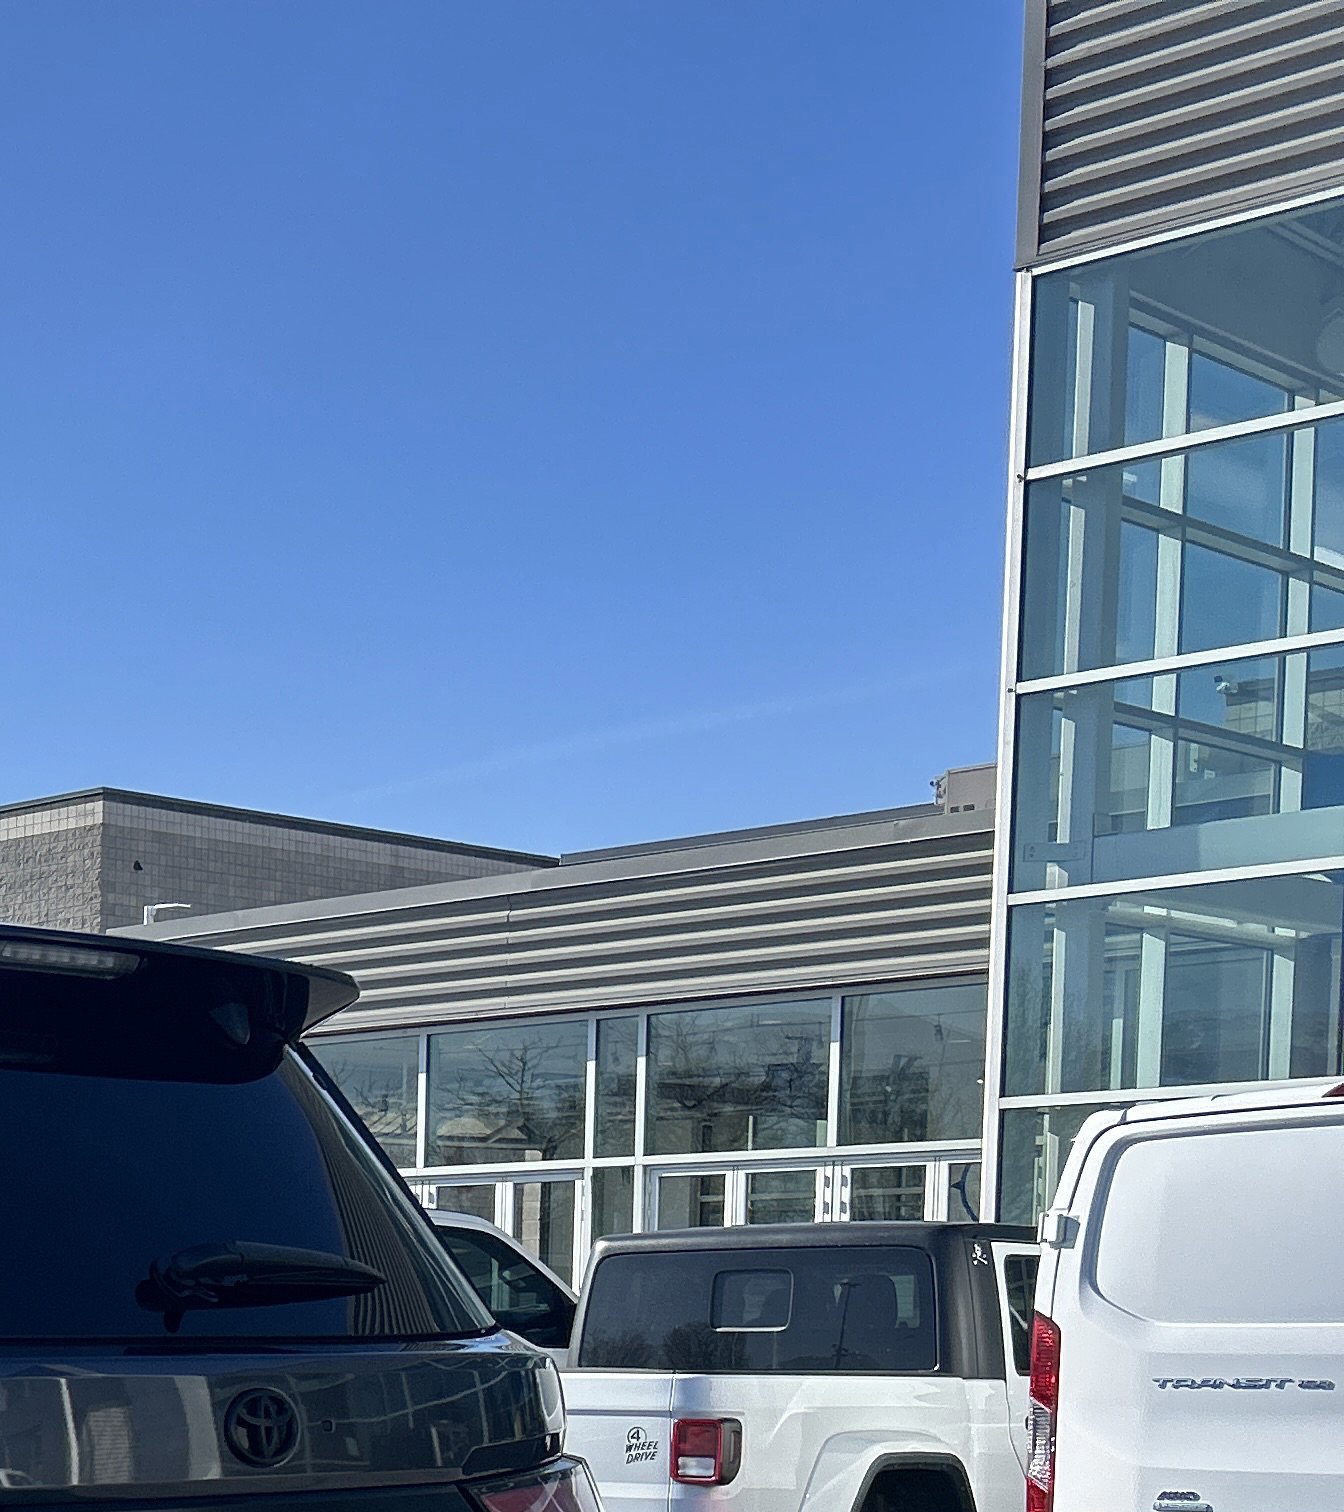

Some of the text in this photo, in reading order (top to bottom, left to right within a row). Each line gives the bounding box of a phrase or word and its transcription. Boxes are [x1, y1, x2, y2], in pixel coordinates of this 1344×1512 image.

[1151, 1377, 1295, 1390] TRANSIT
[625, 1441, 659, 1453] WHEEL
[625, 1451, 658, 1464] DRIVE
